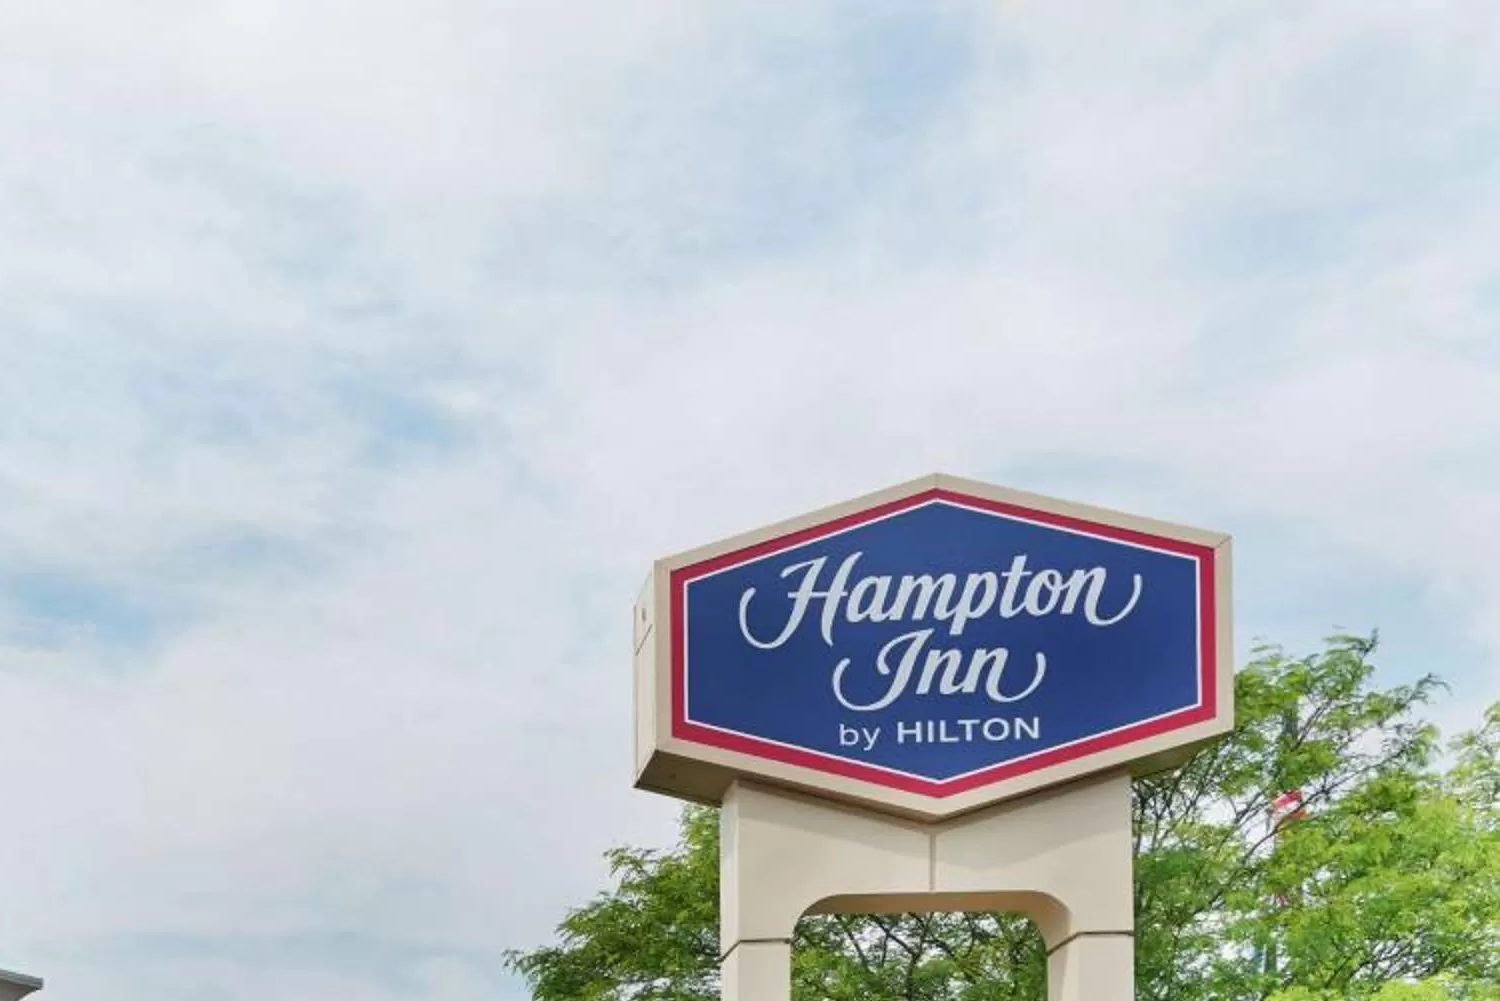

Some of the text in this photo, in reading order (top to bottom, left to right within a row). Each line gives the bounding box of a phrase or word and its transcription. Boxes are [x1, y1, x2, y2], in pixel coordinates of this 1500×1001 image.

[740, 551, 1142, 649] Hampton
[832, 628, 1046, 711] Inn
[839, 717, 1040, 751] by HILTON
